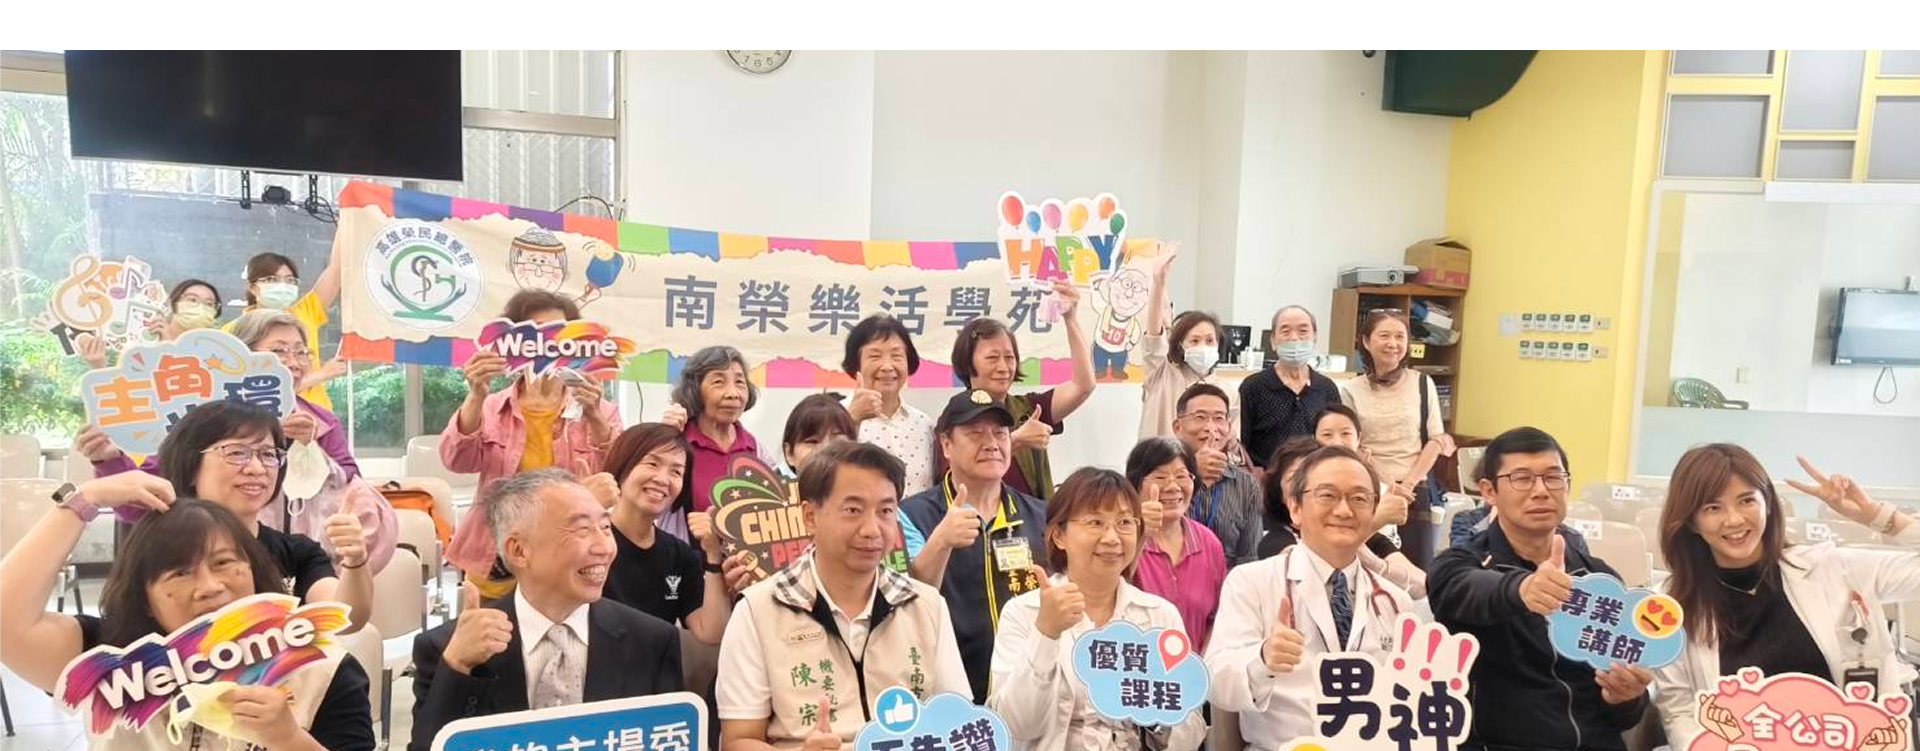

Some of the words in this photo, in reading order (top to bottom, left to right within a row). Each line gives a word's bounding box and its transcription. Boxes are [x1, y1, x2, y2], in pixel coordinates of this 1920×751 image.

[1004, 234, 1118, 284] HAPPY
[664, 275, 1053, 336] 南榮樂活學苑
[496, 332, 618, 358] Welcome
[740, 505, 813, 545] CHIN
[1561, 588, 1623, 627] 專業
[98, 617, 315, 710] Welcome
[1088, 639, 1149, 674] 優質
[1578, 625, 1646, 664] 講師
[1120, 678, 1182, 711] 課程
[1743, 702, 1855, 750] 全公司
